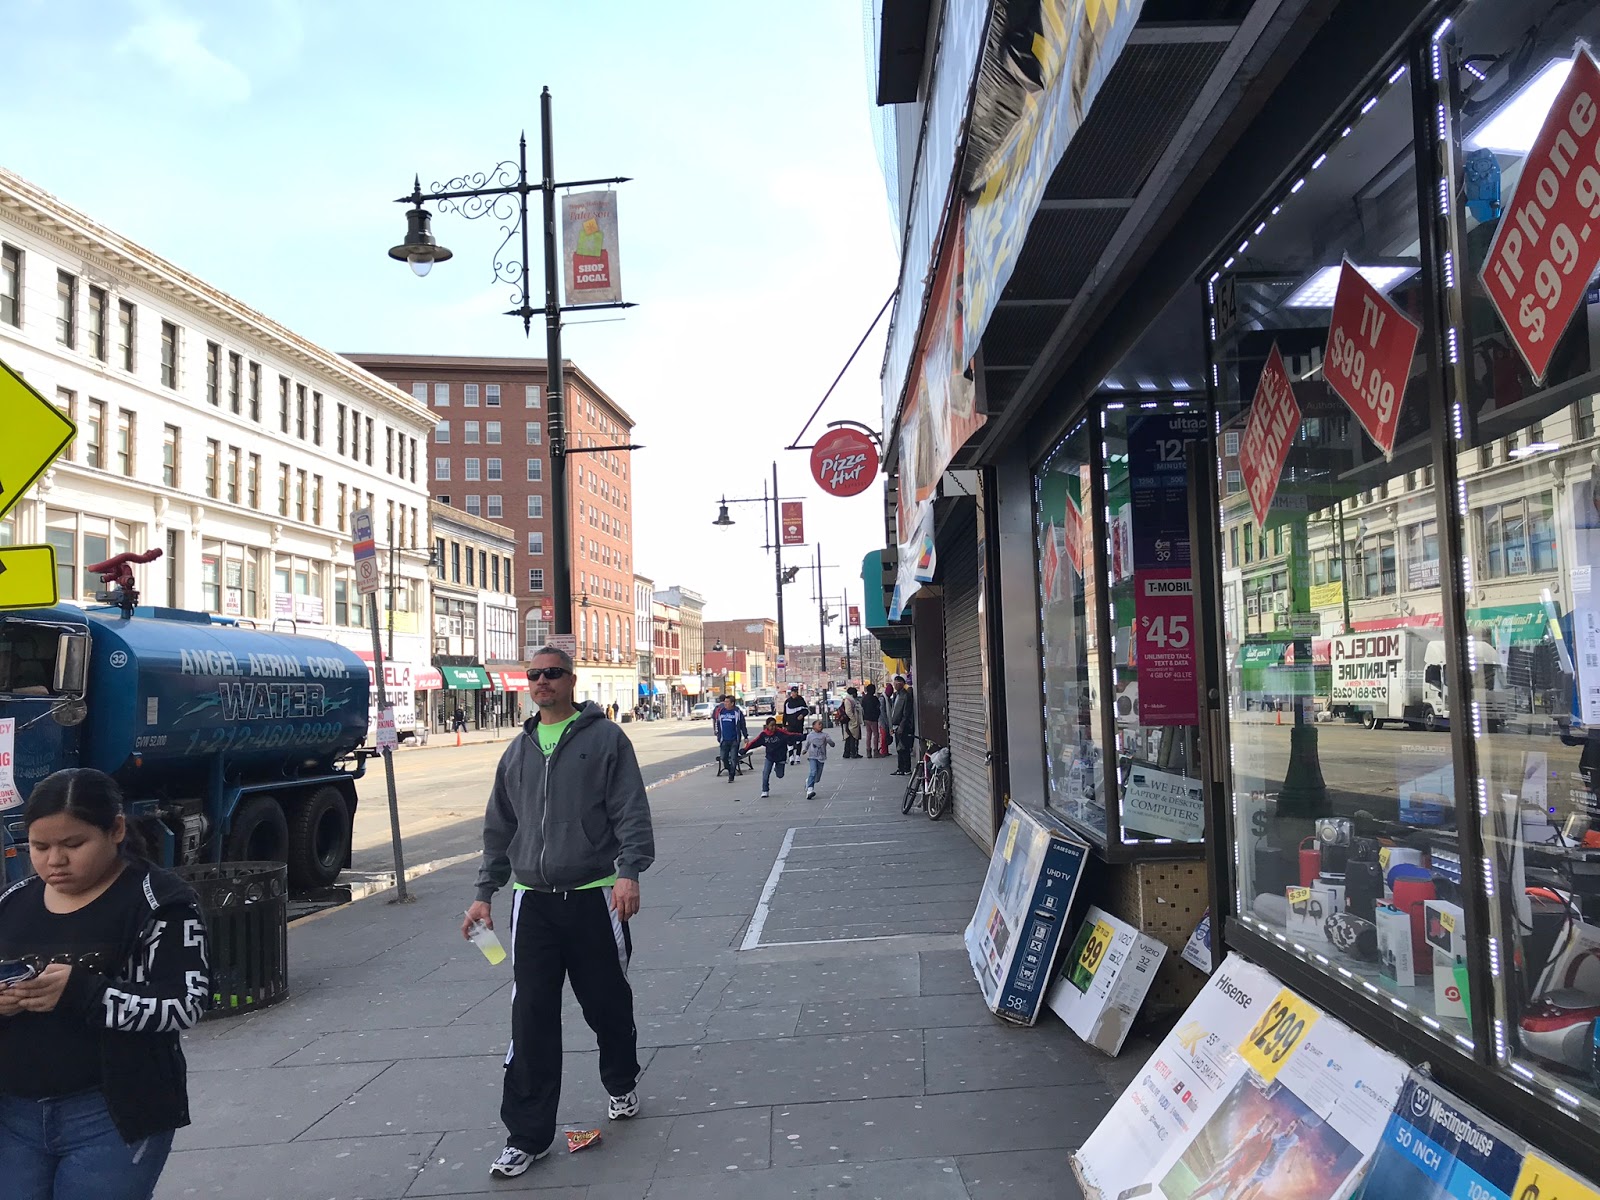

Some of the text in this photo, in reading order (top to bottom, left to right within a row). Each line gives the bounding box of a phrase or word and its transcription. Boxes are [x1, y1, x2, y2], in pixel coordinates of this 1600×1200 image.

[1495, 91, 1597, 299] iPhone
[1519, 137, 1600, 344] $99.9
[577, 274, 607, 283] LOCAL
[578, 264, 604, 273] SHOP
[1360, 294, 1385, 348] TV
[1331, 325, 1395, 424] $99.99
[1169, 418, 1199, 429] ultra
[1246, 372, 1279, 469] FREE
[1250, 393, 1294, 511] PHONE
[820, 453, 867, 479] Pizza
[829, 464, 866, 489] Hut
[1157, 551, 1171, 561] 39
[1148, 582, 1193, 592] T-MOBIL
[1141, 616, 1190, 648] $45
[112, 654, 125, 664] 32
[180, 649, 350, 678] ANGEL AERIAL CORP.
[219, 682, 325, 721] WATER
[1130, 788, 1160, 800] LAPTOP
[1161, 795, 1167, 803] &
[1151, 780, 1186, 796] WE FIX
[1131, 798, 1199, 822] COMPUTERS
[1046, 867, 1071, 881] UHD TV
[1289, 888, 1307, 901] $39
[1443, 912, 1456, 928] SALE
[1082, 936, 1103, 968] 99
[1140, 943, 1160, 958] VIZIO
[1214, 974, 1252, 1010] Hisense
[1251, 999, 1305, 1064] $299
[1429, 1097, 1493, 1158] Westinghouse
[1396, 1127, 1442, 1171] 50 INCH
